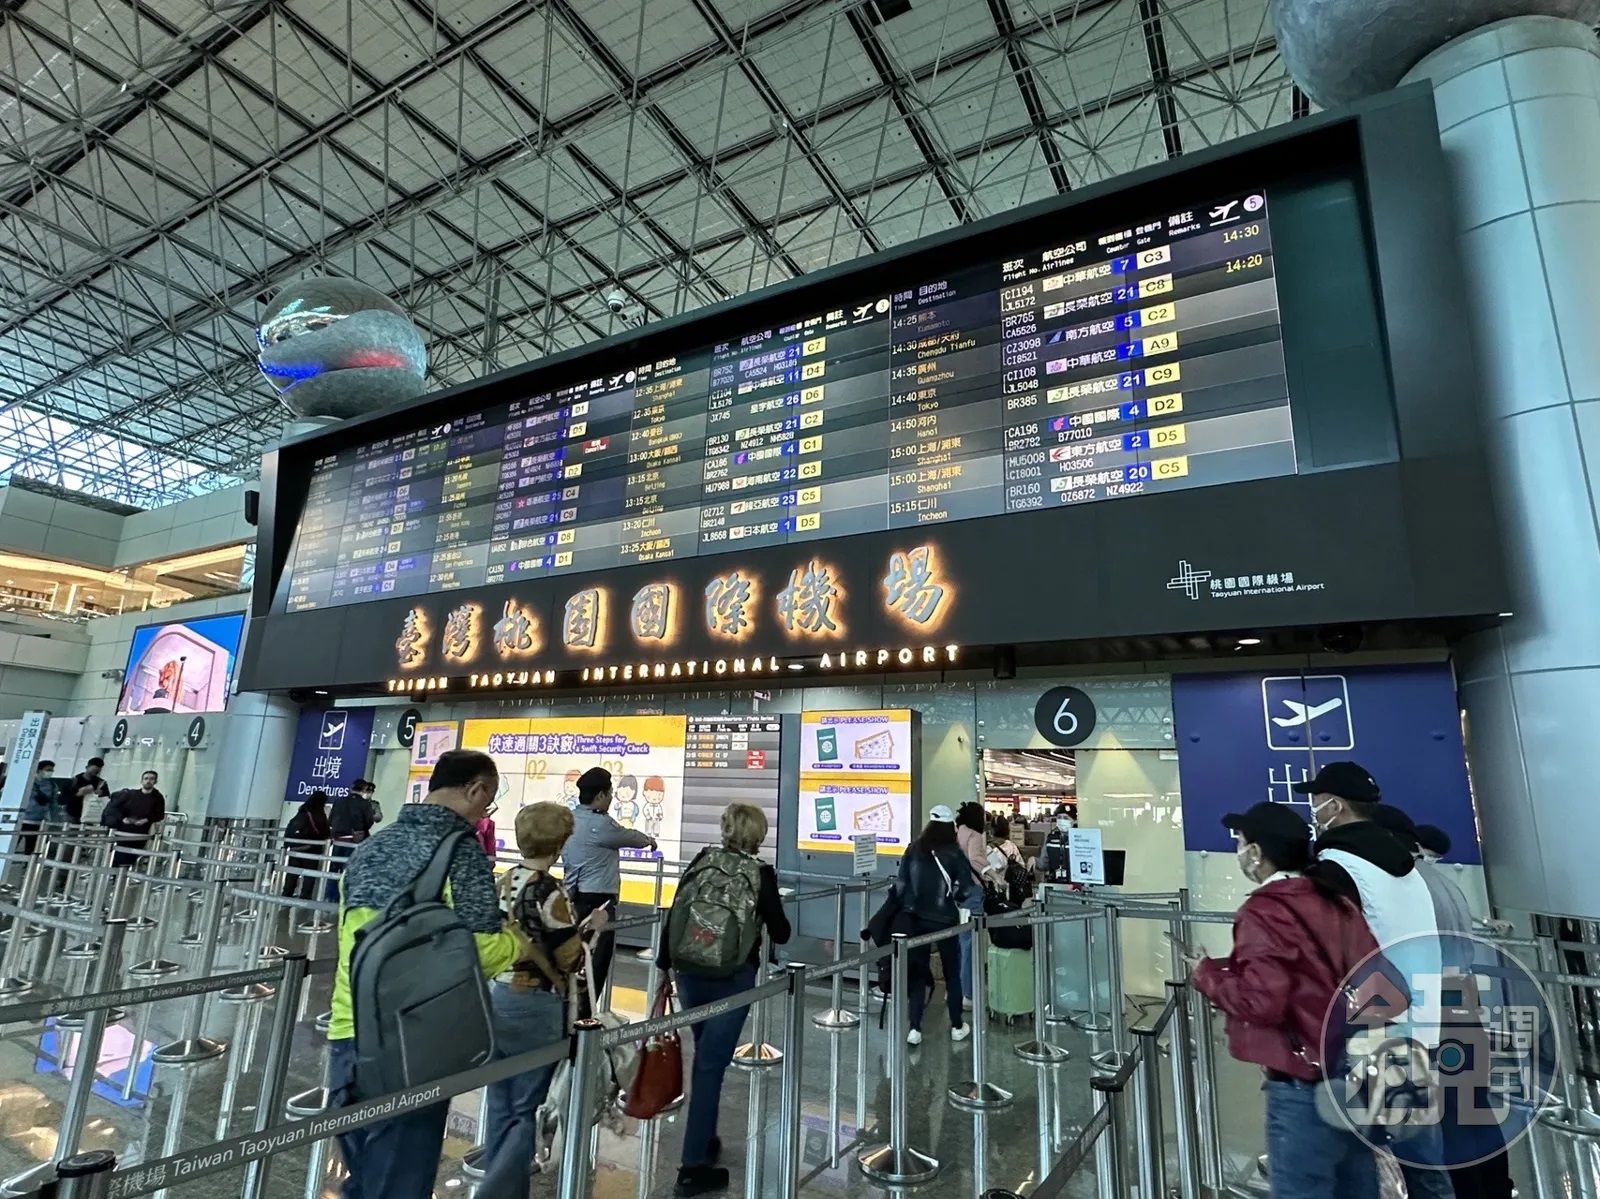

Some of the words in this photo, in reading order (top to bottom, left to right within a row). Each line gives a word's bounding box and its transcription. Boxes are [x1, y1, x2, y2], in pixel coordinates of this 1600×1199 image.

[1002, 259, 1024, 272] 班次
[1042, 241, 1087, 262] 航空公司
[1168, 211, 1194, 227] 備註
[1042, 257, 1074, 271] Airlines
[1169, 223, 1201, 236] Remarks
[1005, 285, 1034, 300] CI194
[1063, 264, 1112, 285] 中華航空
[1120, 260, 1129, 271] 7
[1143, 250, 1164, 263] C3
[1223, 225, 1260, 243] 14:30
[1005, 312, 1035, 328] BR765
[1063, 292, 1112, 313] 長榮航空
[1117, 287, 1134, 300] 21
[1145, 279, 1166, 292] C8
[1226, 255, 1263, 273] 14:20
[1005, 296, 1036, 312] JL5172
[893, 315, 917, 330] 14:25
[1005, 323, 1037, 338] CA5526
[1006, 338, 1041, 355] CZ3098
[1065, 322, 1115, 341] 南方航空
[1124, 316, 1133, 327] 5
[1148, 308, 1168, 321] C2
[807, 341, 821, 352] C7
[892, 341, 917, 355] 14:30
[950, 339, 976, 351] Tianfu
[1006, 367, 1036, 382] CI108
[1067, 349, 1116, 369] 中華航空
[1126, 345, 1136, 356] 7
[1149, 338, 1170, 351] A9
[1006, 352, 1038, 368] CI8521
[789, 370, 799, 382] 11
[806, 366, 821, 377] D4
[892, 365, 917, 380] 14:35
[1007, 379, 1039, 394] JL5048
[1007, 395, 1037, 410] BR385
[1067, 377, 1118, 399] 長榮航空
[1122, 374, 1140, 387] 21
[1152, 368, 1173, 381] C9
[786, 394, 800, 406] 26
[806, 389, 819, 400] D6
[892, 392, 916, 406] 14:40
[575, 405, 585, 413] D1
[918, 401, 938, 411] Tokyo
[891, 419, 916, 432] 14:50
[1008, 423, 1038, 438] CA196
[1069, 407, 1120, 427] 中國國際
[1128, 405, 1140, 417] 4
[1154, 398, 1175, 412] D2
[573, 426, 583, 434] D5
[632, 429, 649, 441] 12:40
[709, 434, 729, 446] BR130
[785, 420, 798, 431] 21
[804, 415, 819, 424] C2
[787, 445, 795, 454] 4
[804, 439, 817, 449] C1
[891, 445, 917, 459] 15:00
[1009, 451, 1045, 467] MU5008
[1070, 438, 1122, 458] 東方航空
[1131, 436, 1142, 448] 2
[1156, 429, 1178, 443] D5
[630, 452, 648, 463] 13:00
[568, 467, 579, 476] D2
[783, 469, 796, 479] 22
[803, 464, 817, 474] C3
[1009, 466, 1042, 480] CI8001
[627, 474, 645, 485] 13:15
[891, 473, 917, 486] 15:00
[1009, 483, 1041, 498] BR160
[1071, 469, 1124, 490] 長榮航空
[1128, 466, 1148, 480] 20
[1159, 461, 1180, 475] C5
[566, 490, 576, 498] C4
[1106, 481, 1144, 497] NZ4922
[625, 497, 643, 508] 13:15
[782, 495, 795, 506] 23
[802, 491, 816, 501] C5
[890, 500, 917, 514] 15:15
[918, 497, 937, 511] 仁川
[918, 510, 948, 522] Incheon
[623, 520, 641, 531] 13:20
[744, 522, 779, 537] 日本航空
[801, 517, 815, 528] D5
[621, 543, 639, 554] 13:25
[558, 555, 568, 563] D1
[1210, 572, 1293, 590] 桃園國際機場
[1211, 590, 1242, 598] Taoyuan
[1244, 585, 1294, 595] International
[1296, 583, 1325, 592] Airport
[396, 547, 943, 664] 臺灣桃園國際機場
[388, 677, 448, 691] TAIWAN
[471, 670, 555, 688] TAOYUAN
[583, 656, 780, 681] INTERNATIONAL
[820, 645, 959, 668] AIRPORT
[868, 716, 888, 724] SHOW
[1053, 697, 1078, 735] 6
[116, 724, 125, 742] 3
[190, 722, 200, 741] 4
[403, 716, 416, 740] 5
[22, 718, 40, 759] 出境入口
[489, 734, 576, 755] 快速通關3訣竅
[577, 735, 595, 744] Three
[596, 736, 614, 746] Steps
[615, 735, 626, 744] for
[581, 744, 599, 753] Swift
[600, 744, 626, 755] Security
[627, 745, 649, 754] Check
[312, 755, 342, 779] 出境
[528, 760, 546, 780] 02
[867, 787, 888, 795] SHOW
[148, 985, 182, 1001] Taiwan
[185, 978, 226, 993] Taoyuan
[619, 1023, 644, 1039] Taiwan
[644, 1017, 671, 1034] Taoyuan
[672, 1006, 709, 1026] International
[709, 1002, 729, 1015] Airport
[173, 1150, 233, 1177] Taiwan
[239, 1127, 305, 1156] Taoyuan
[309, 1100, 395, 1136] International
[397, 1085, 441, 1110] Airport
